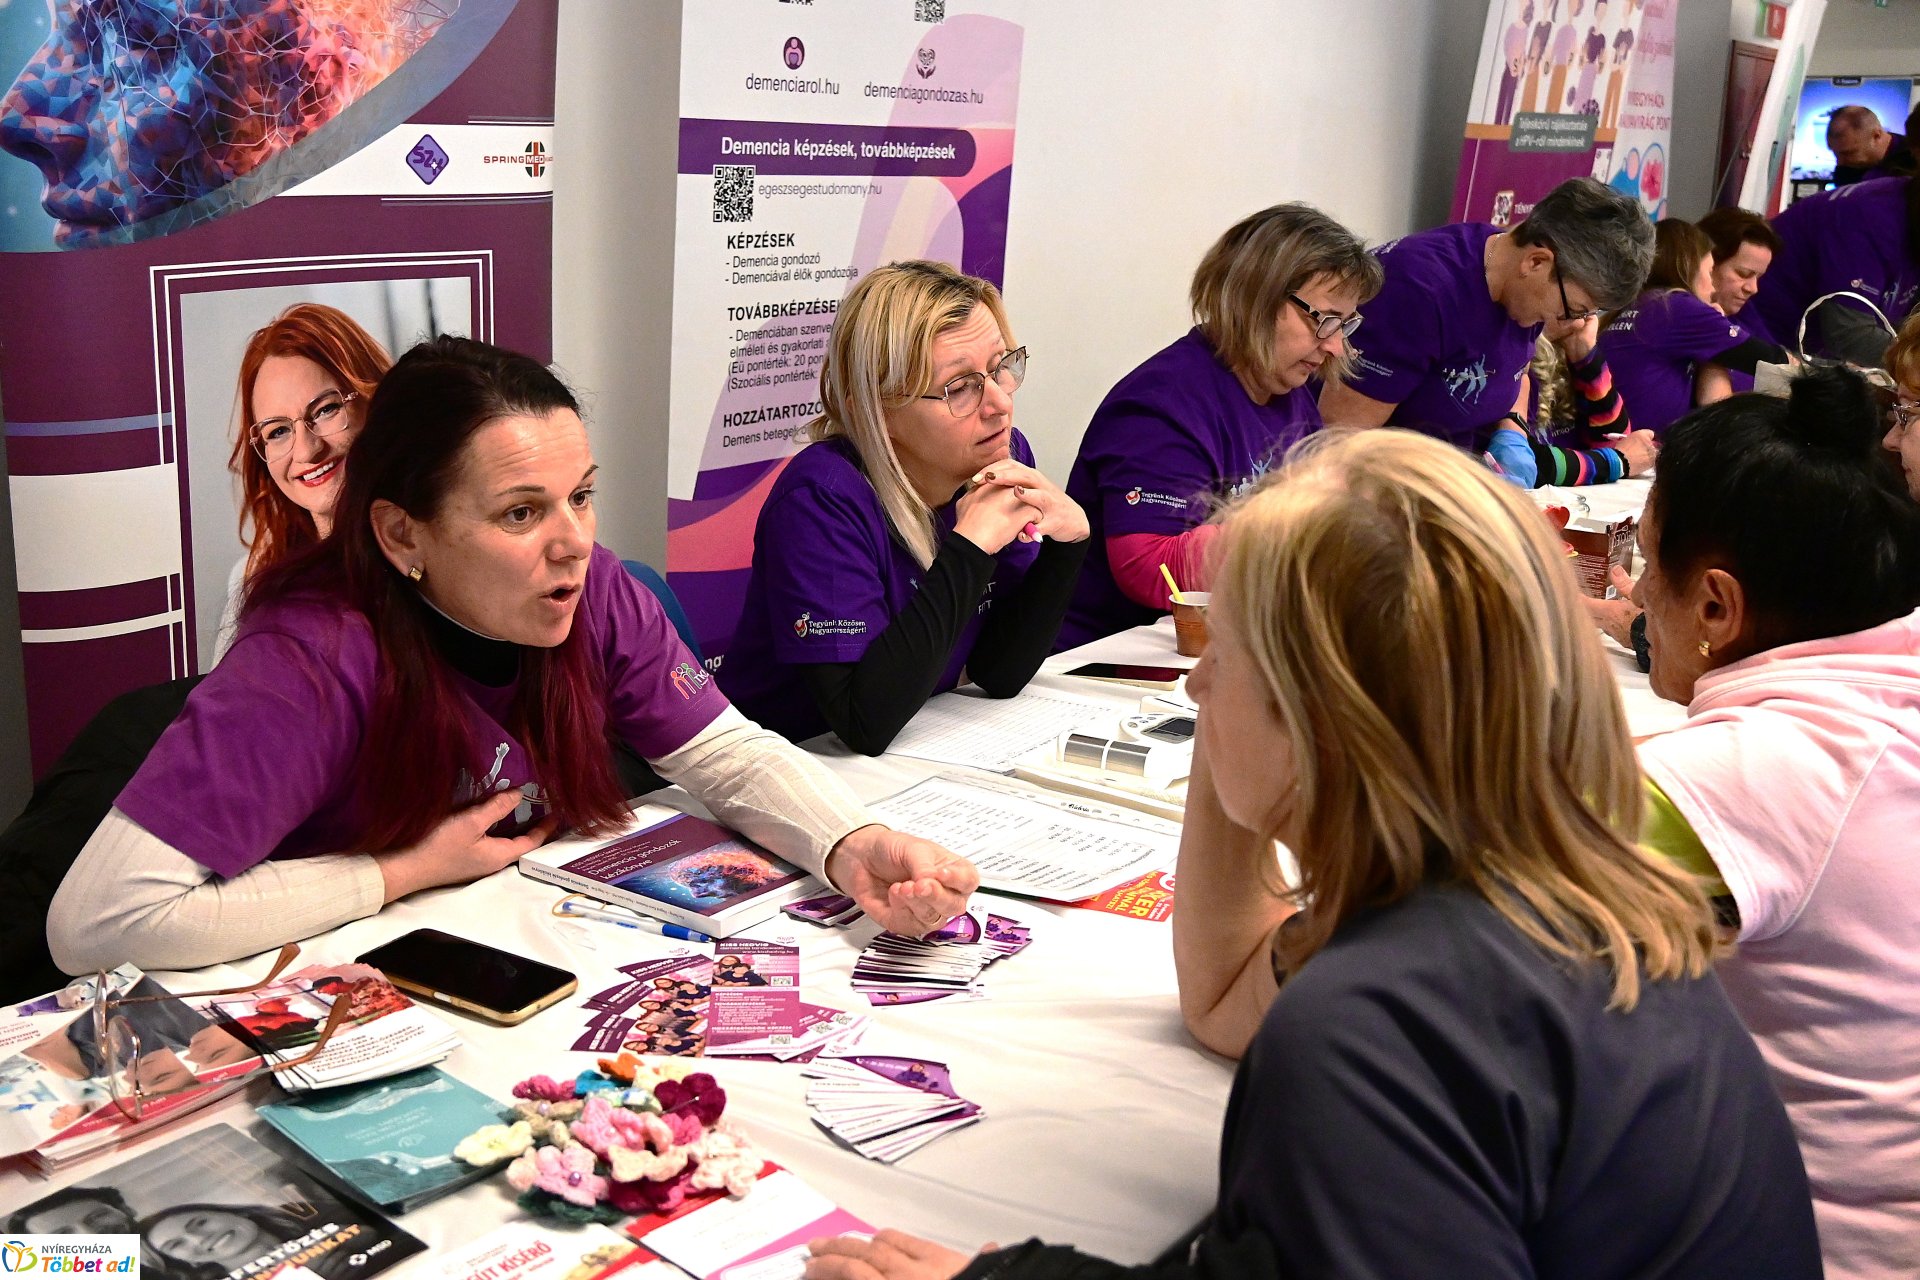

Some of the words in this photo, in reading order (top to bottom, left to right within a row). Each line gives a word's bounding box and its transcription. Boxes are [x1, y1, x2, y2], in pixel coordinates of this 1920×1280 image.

[745, 73, 840, 95] demenciarol.hu
[864, 81, 984, 104] demenciagondozas.hu
[721, 136, 790, 157] Demencia
[793, 139, 858, 160] képzések,
[861, 140, 956, 160] továbbképzések
[758, 181, 882, 198] egeszsegestudomany.hu
[727, 231, 795, 250] KÉPZÉSEK
[732, 254, 779, 268] Demencia
[781, 252, 821, 268] gondozó
[732, 270, 791, 285] Demenciával
[794, 268, 812, 282] élők
[814, 265, 859, 282] gondozója
[736, 325, 798, 342] Demenciában
[800, 323, 834, 336] szenve
[730, 341, 766, 358] elméleti
[767, 341, 779, 355] és
[781, 337, 824, 356] gyakorlati
[747, 357, 792, 374] pontérték:
[794, 355, 806, 367] 20
[808, 355, 824, 368] pon
[727, 375, 771, 392] (Szociális
[773, 371, 818, 388] pontérték:
[723, 429, 761, 448] Demens
[588, 855, 637, 876] Demencia
